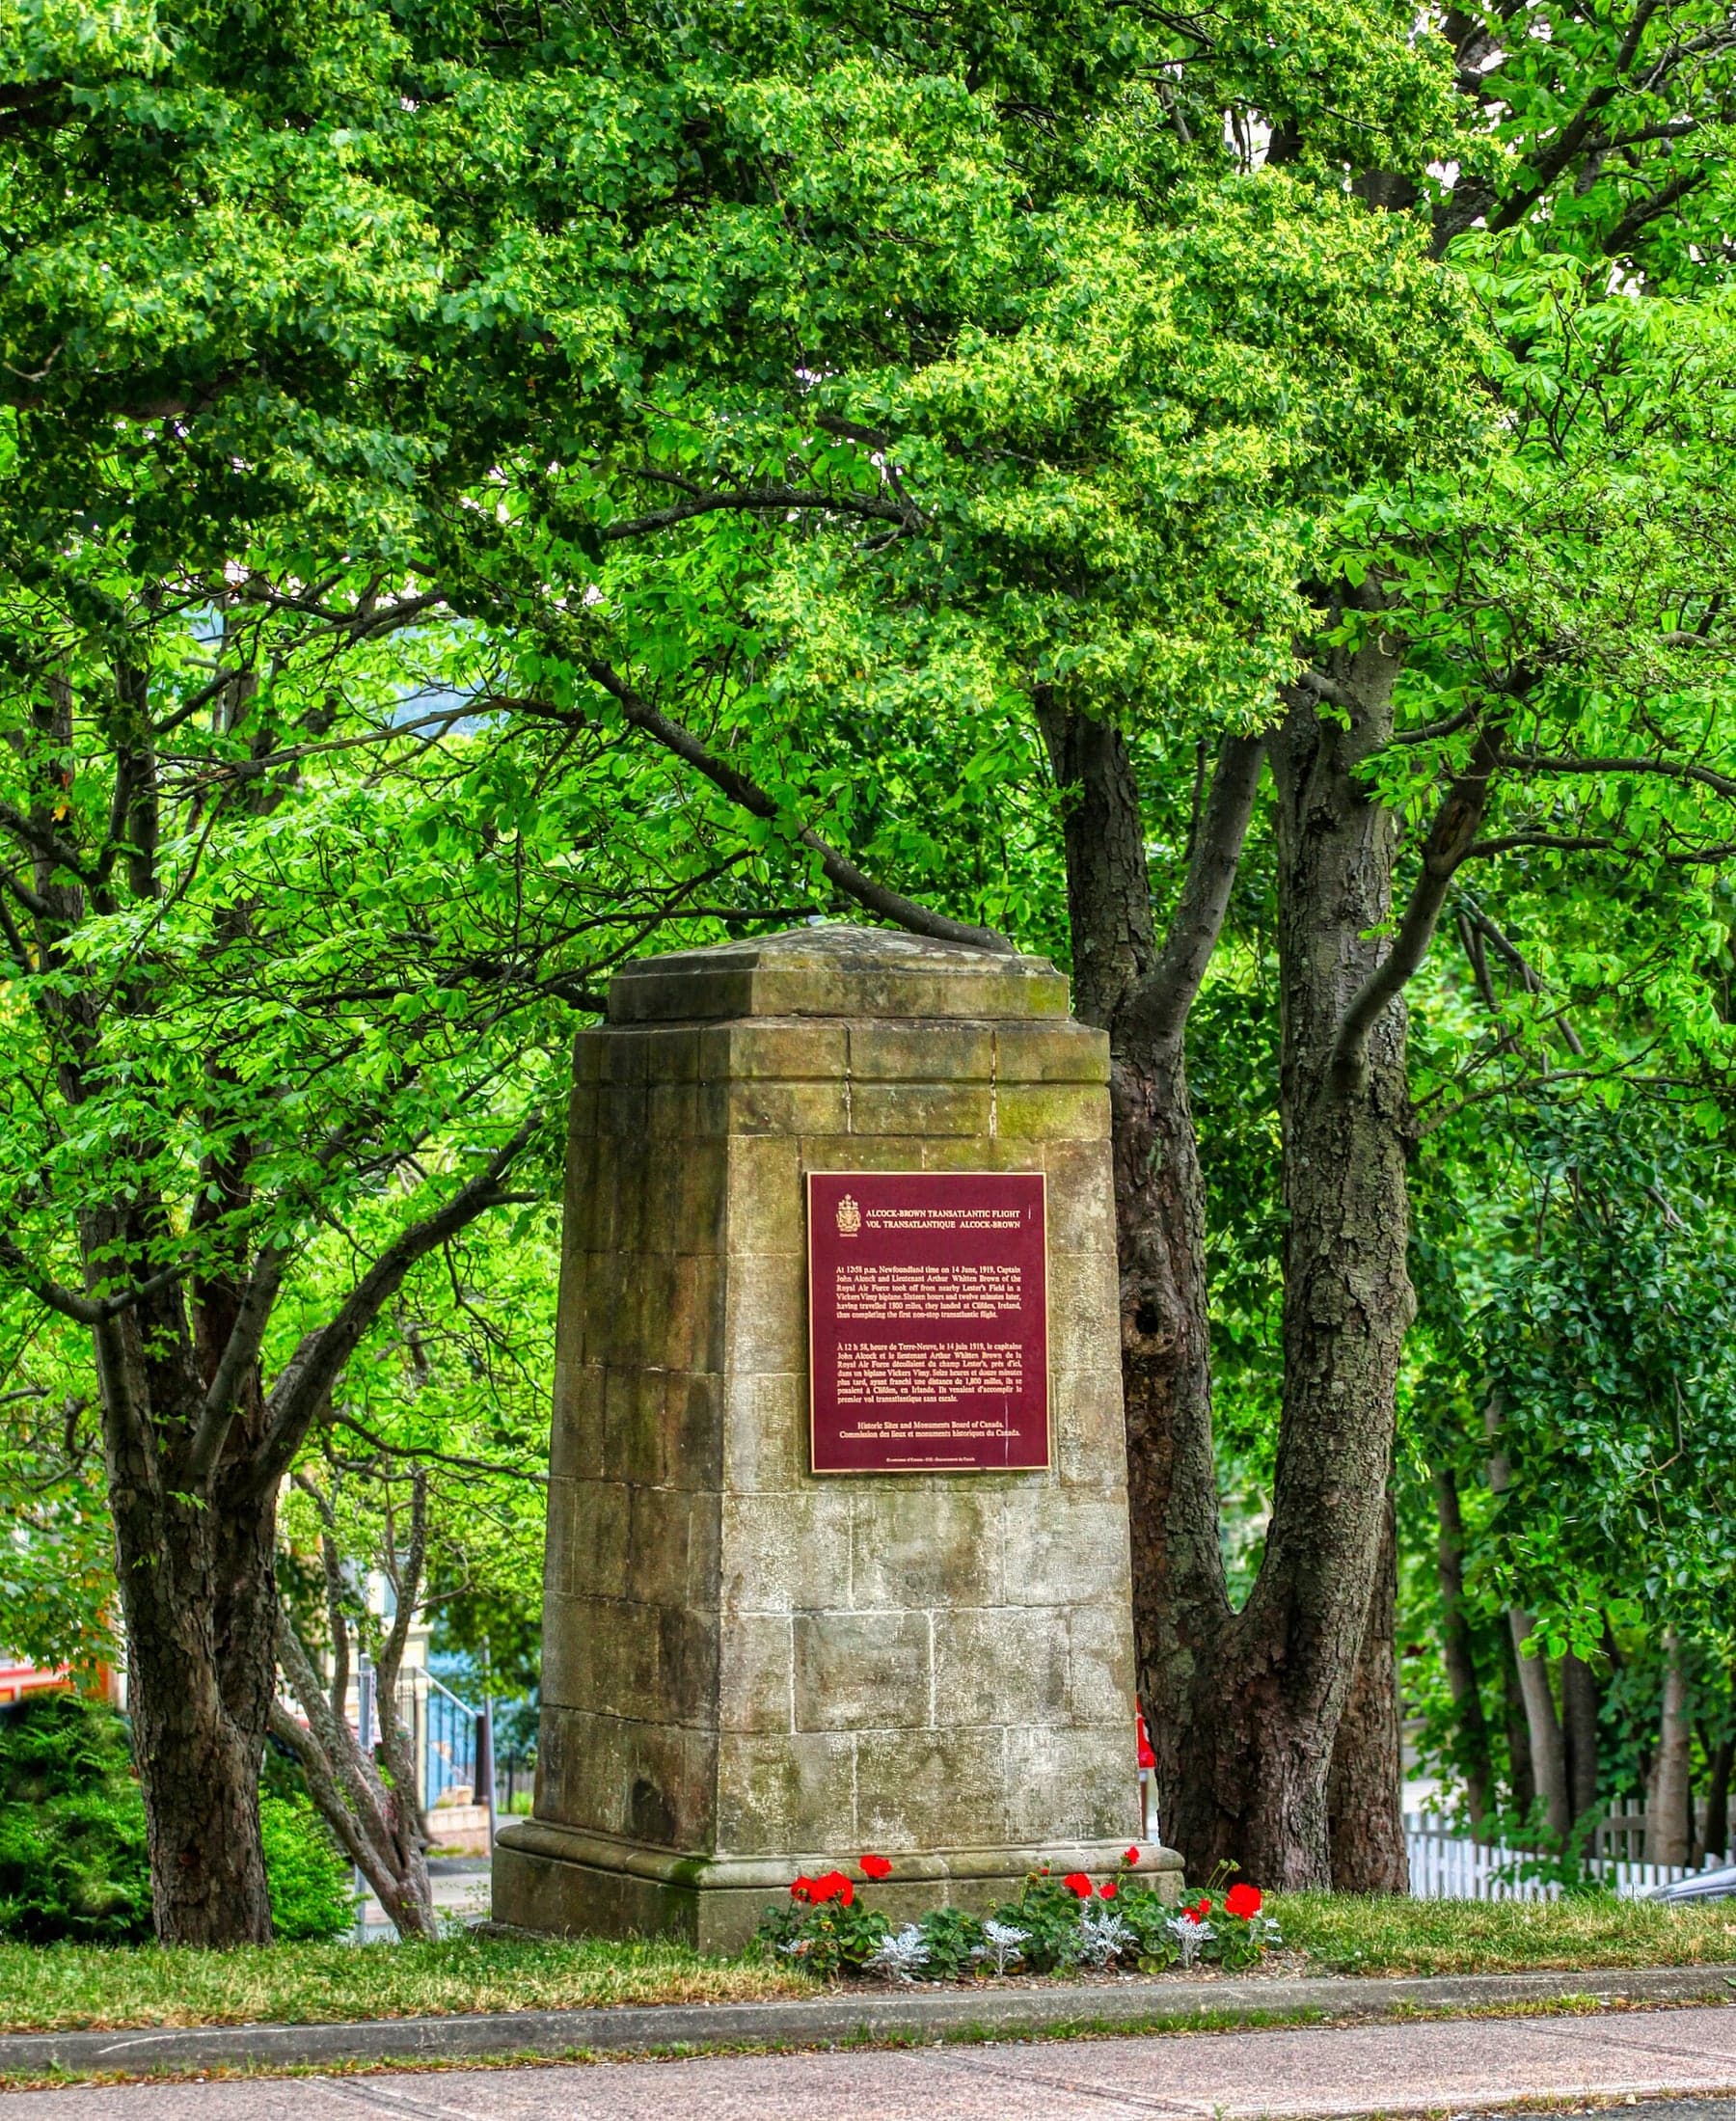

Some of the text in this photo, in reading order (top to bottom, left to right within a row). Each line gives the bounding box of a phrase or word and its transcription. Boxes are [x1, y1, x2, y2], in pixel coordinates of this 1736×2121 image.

[866, 1220, 1020, 1229] VOL TRANSATLANTIQUE ALCOCK-BROWN
